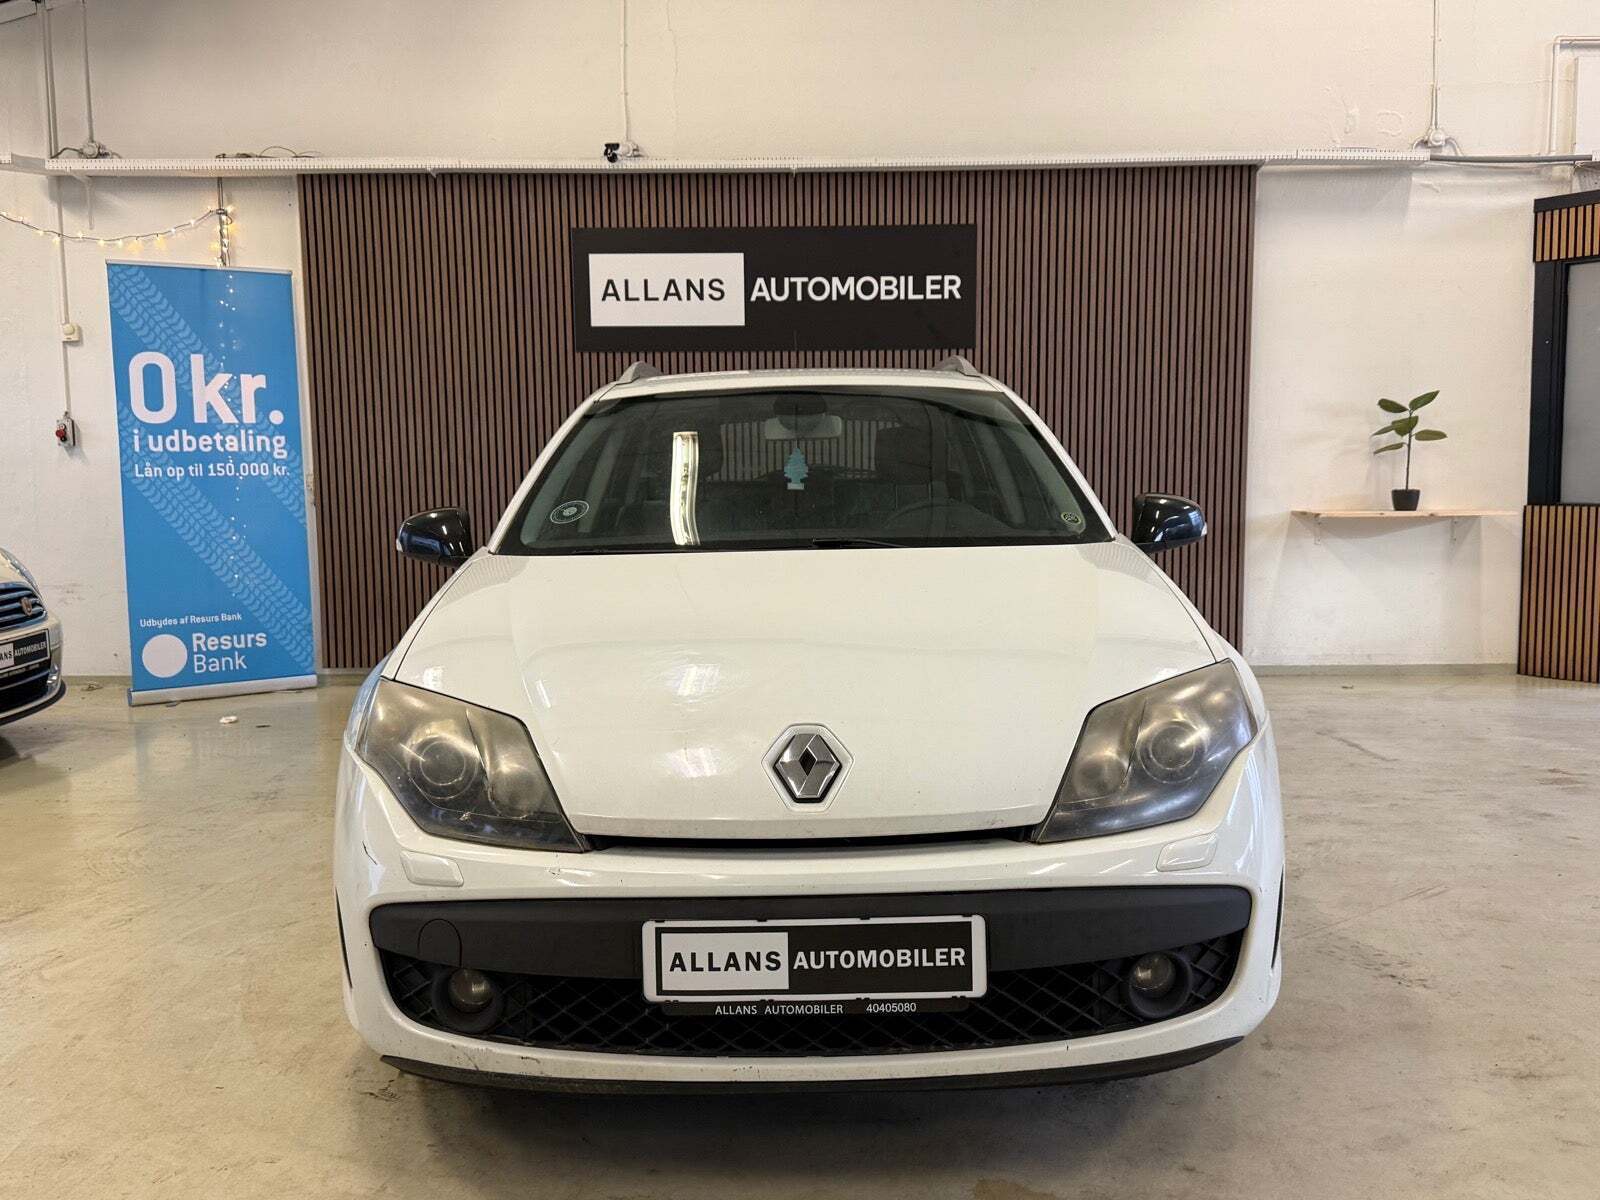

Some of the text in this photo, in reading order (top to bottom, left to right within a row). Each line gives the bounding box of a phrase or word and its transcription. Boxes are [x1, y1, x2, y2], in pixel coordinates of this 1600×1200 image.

[601, 274, 962, 302] ALLANS AUTOMOBILER
[129, 351, 285, 425] 0 kr.
[132, 428, 288, 460] i udbetaling
[134, 461, 290, 480] Lån op til 150.000 kr.
[139, 612, 242, 629] Udbydes af Resurs Bank
[15, 641, 47, 656] AUTOMOBILER
[192, 632, 267, 652] Resurs
[193, 651, 248, 674] Bank
[669, 947, 966, 972] ALLANS AUTOMOBILER
[715, 1002, 917, 1016] ALLANS AUTOMOBILER 40405080
